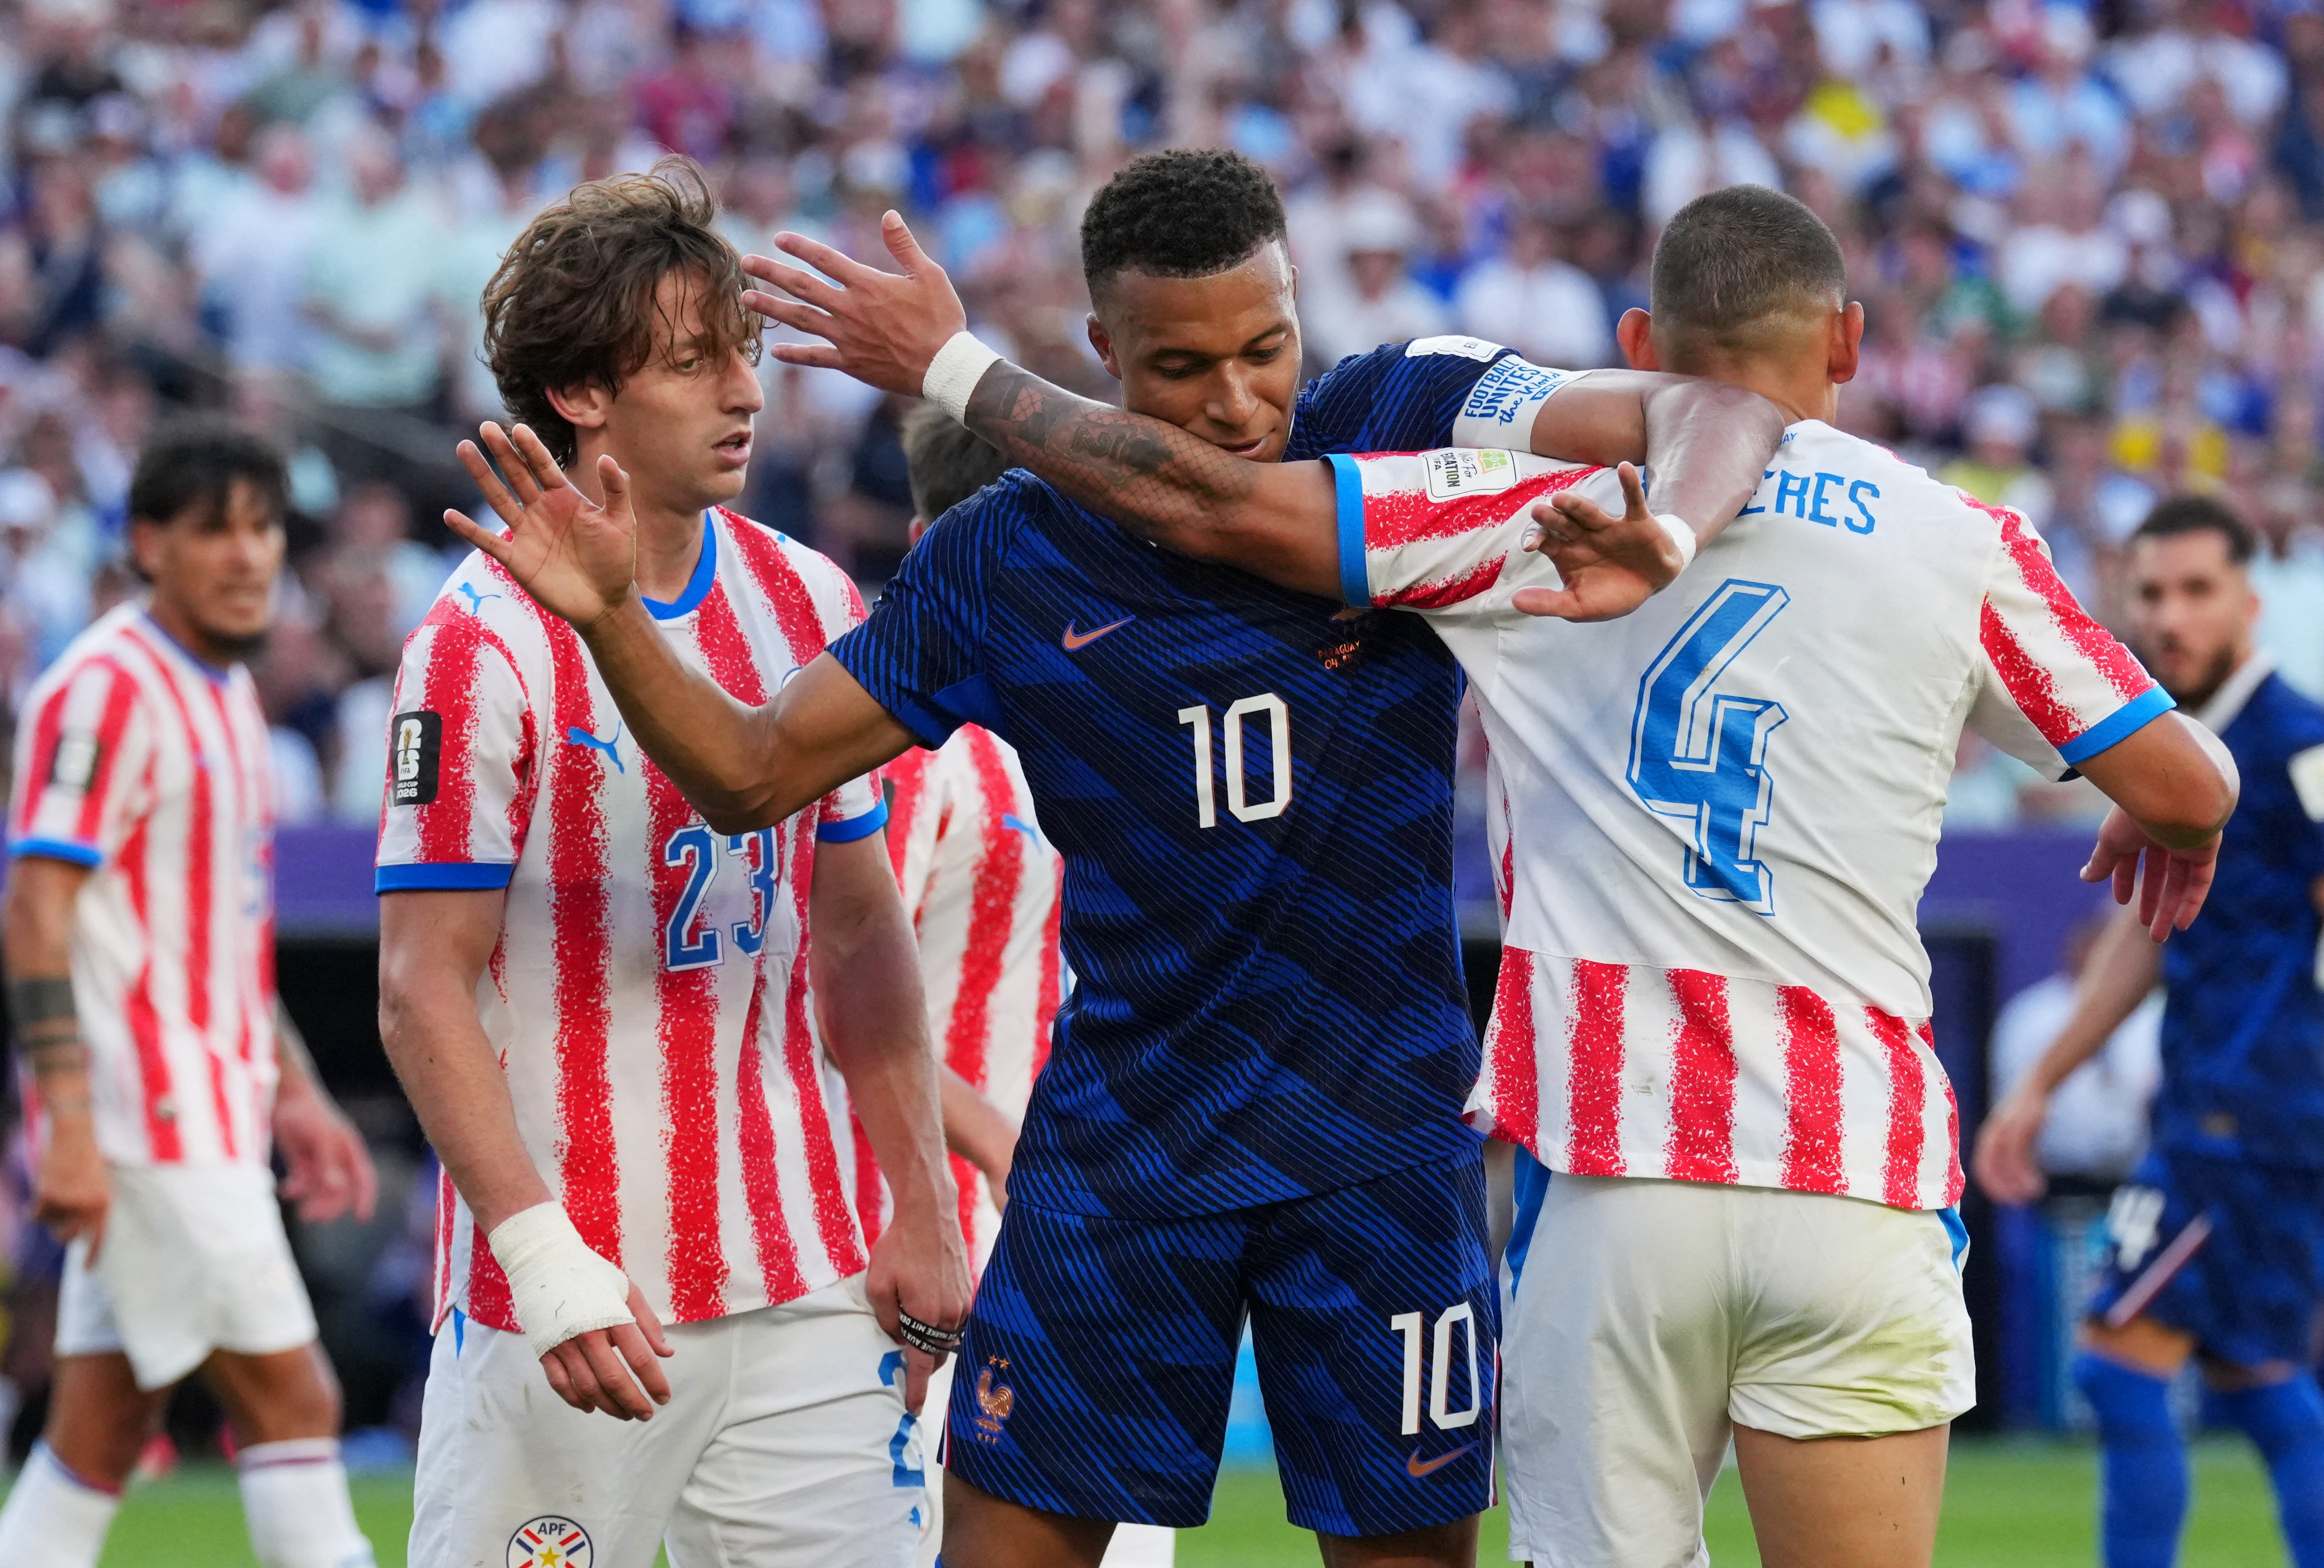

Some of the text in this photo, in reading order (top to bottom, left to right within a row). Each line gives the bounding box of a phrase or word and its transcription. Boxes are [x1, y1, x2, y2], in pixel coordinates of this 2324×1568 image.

[1464, 359, 1520, 418] FOOTBALL
[1478, 367, 1541, 418] UNITES
[1499, 371, 1561, 426] the World
[1461, 464, 1477, 479] For
[1317, 640, 1360, 658] PARAGUAY
[1178, 692, 1292, 828] 10
[1626, 578, 1791, 916] 4
[664, 824, 779, 973] 23
[906, 1332, 921, 1346] AUX
[911, 1321, 926, 1333] MIT
[1391, 1301, 1481, 1435] 10
[537, 1522, 567, 1536] APF
